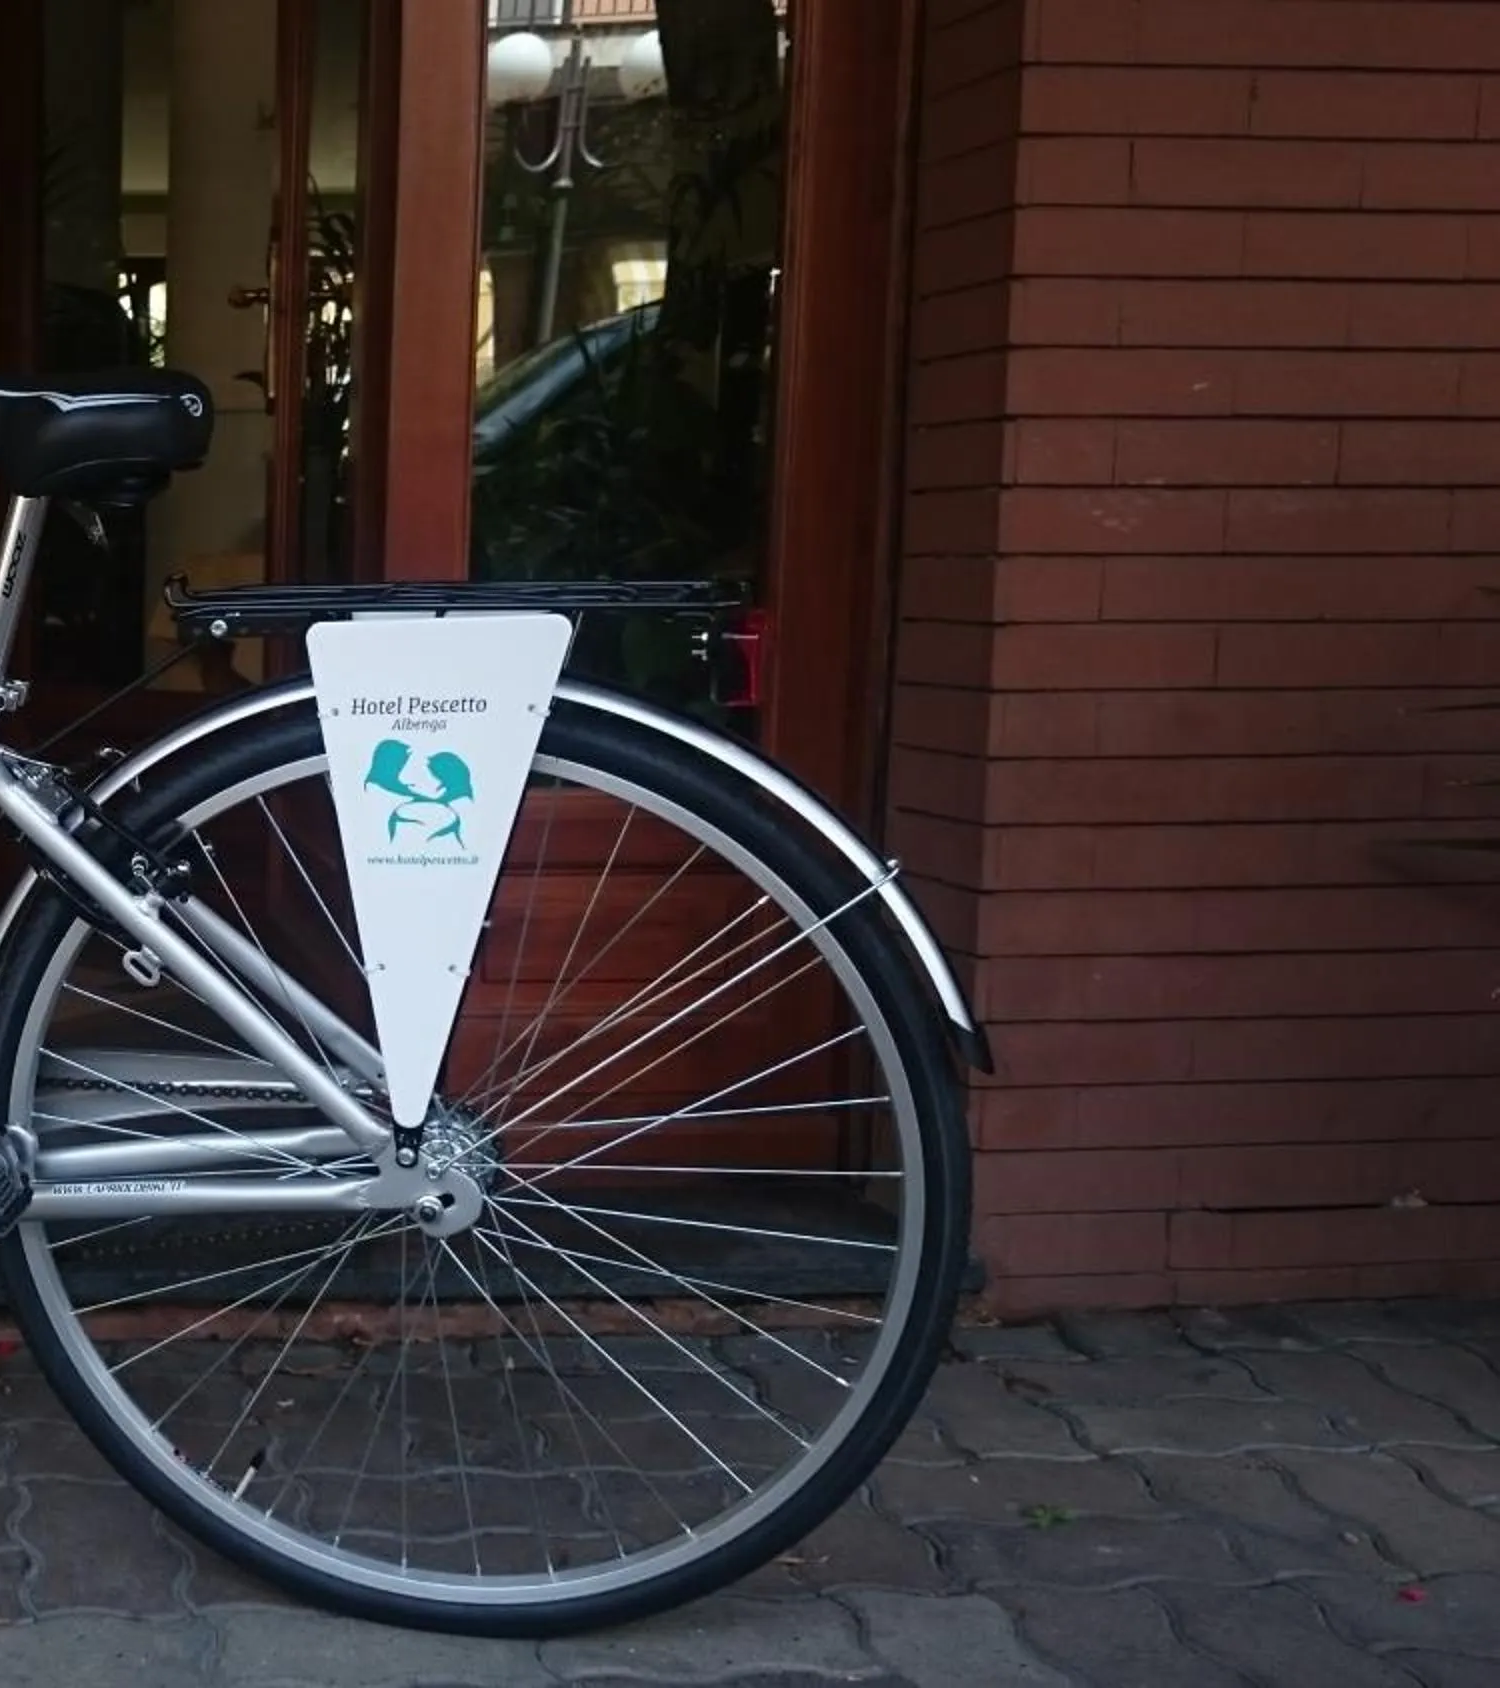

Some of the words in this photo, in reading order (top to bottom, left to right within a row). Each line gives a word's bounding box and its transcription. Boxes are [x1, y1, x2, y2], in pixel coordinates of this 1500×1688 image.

[351, 696, 402, 716] Hotel
[408, 696, 488, 715] Pescetto
[391, 717, 448, 732] Albenga
